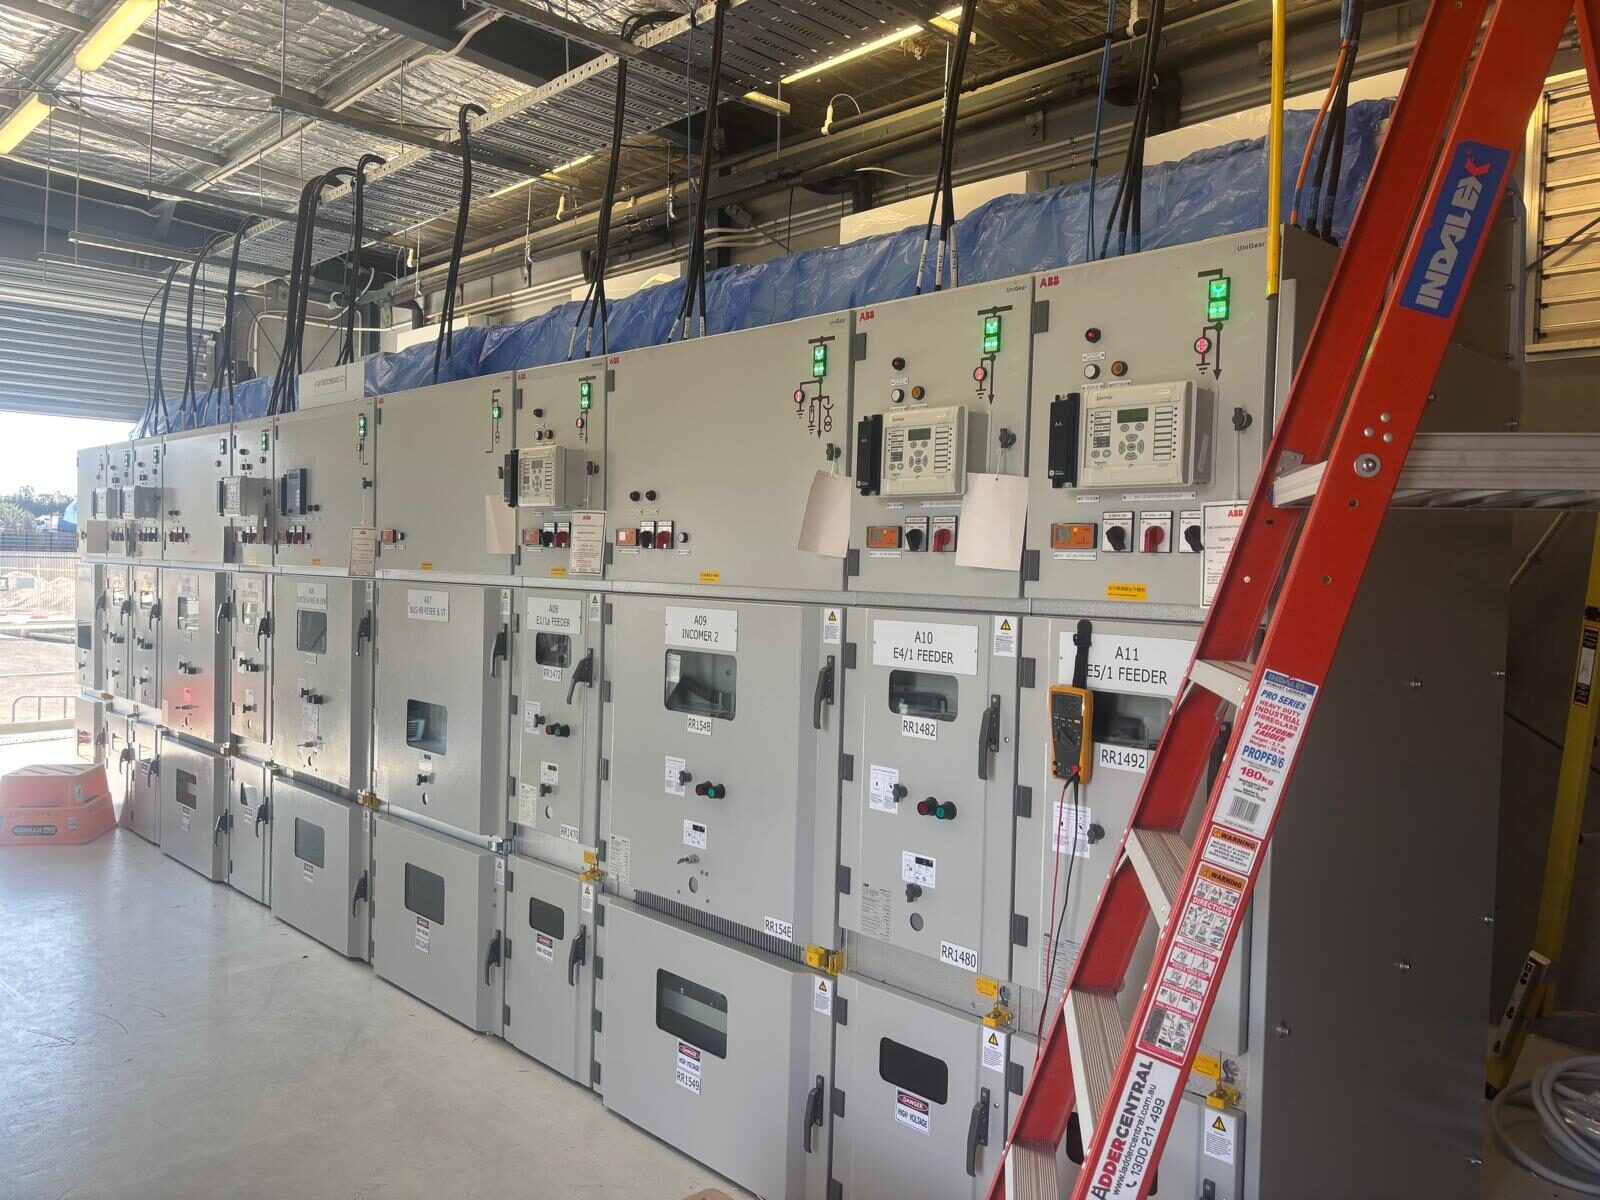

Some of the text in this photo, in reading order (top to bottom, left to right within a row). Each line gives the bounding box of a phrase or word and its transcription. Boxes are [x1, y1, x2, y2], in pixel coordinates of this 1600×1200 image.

[1415, 150, 1491, 309] INDALEX
[1237, 241, 1265, 252] UniGear
[1006, 284, 1028, 294] UniGear
[1040, 275, 1060, 288] ABB
[859, 310, 875, 322] ABB
[609, 356, 620, 365] ABB
[517, 373, 527, 381] ABB
[1228, 509, 1244, 518] ABB
[551, 617, 571, 628] FEEDER
[693, 615, 708, 626] A09
[682, 628, 719, 643] INCOMER 2
[914, 630, 933, 645] A10
[893, 646, 954, 665] E4/1 FEEDER
[1115, 646, 1139, 662] A11
[1086, 663, 1168, 686] E5/1 FEEDER
[1259, 699, 1301, 717] HEAVY DUTY
[1260, 689, 1306, 710] PRO SERIES
[1253, 711, 1299, 731] FIBREGLASS
[1254, 704, 1301, 726] INDUSTRIAL
[902, 720, 937, 737] RR1482
[1101, 748, 1146, 769] RR1492
[1241, 744, 1285, 768] PROPF9/6
[1220, 832, 1256, 849] WARNING
[1210, 871, 1242, 889] WARNING
[1191, 896, 1232, 916] DIRECTIONS
[941, 944, 977, 968] RR1480
[676, 1070, 700, 1091] RR1549
[903, 1096, 924, 1109] DANGER
[897, 1108, 928, 1128] HIGH VOLTAGE
[1113, 1084, 1157, 1196] www.laddercentral.com.au
[1131, 1098, 1166, 1176] 1300 211 499
